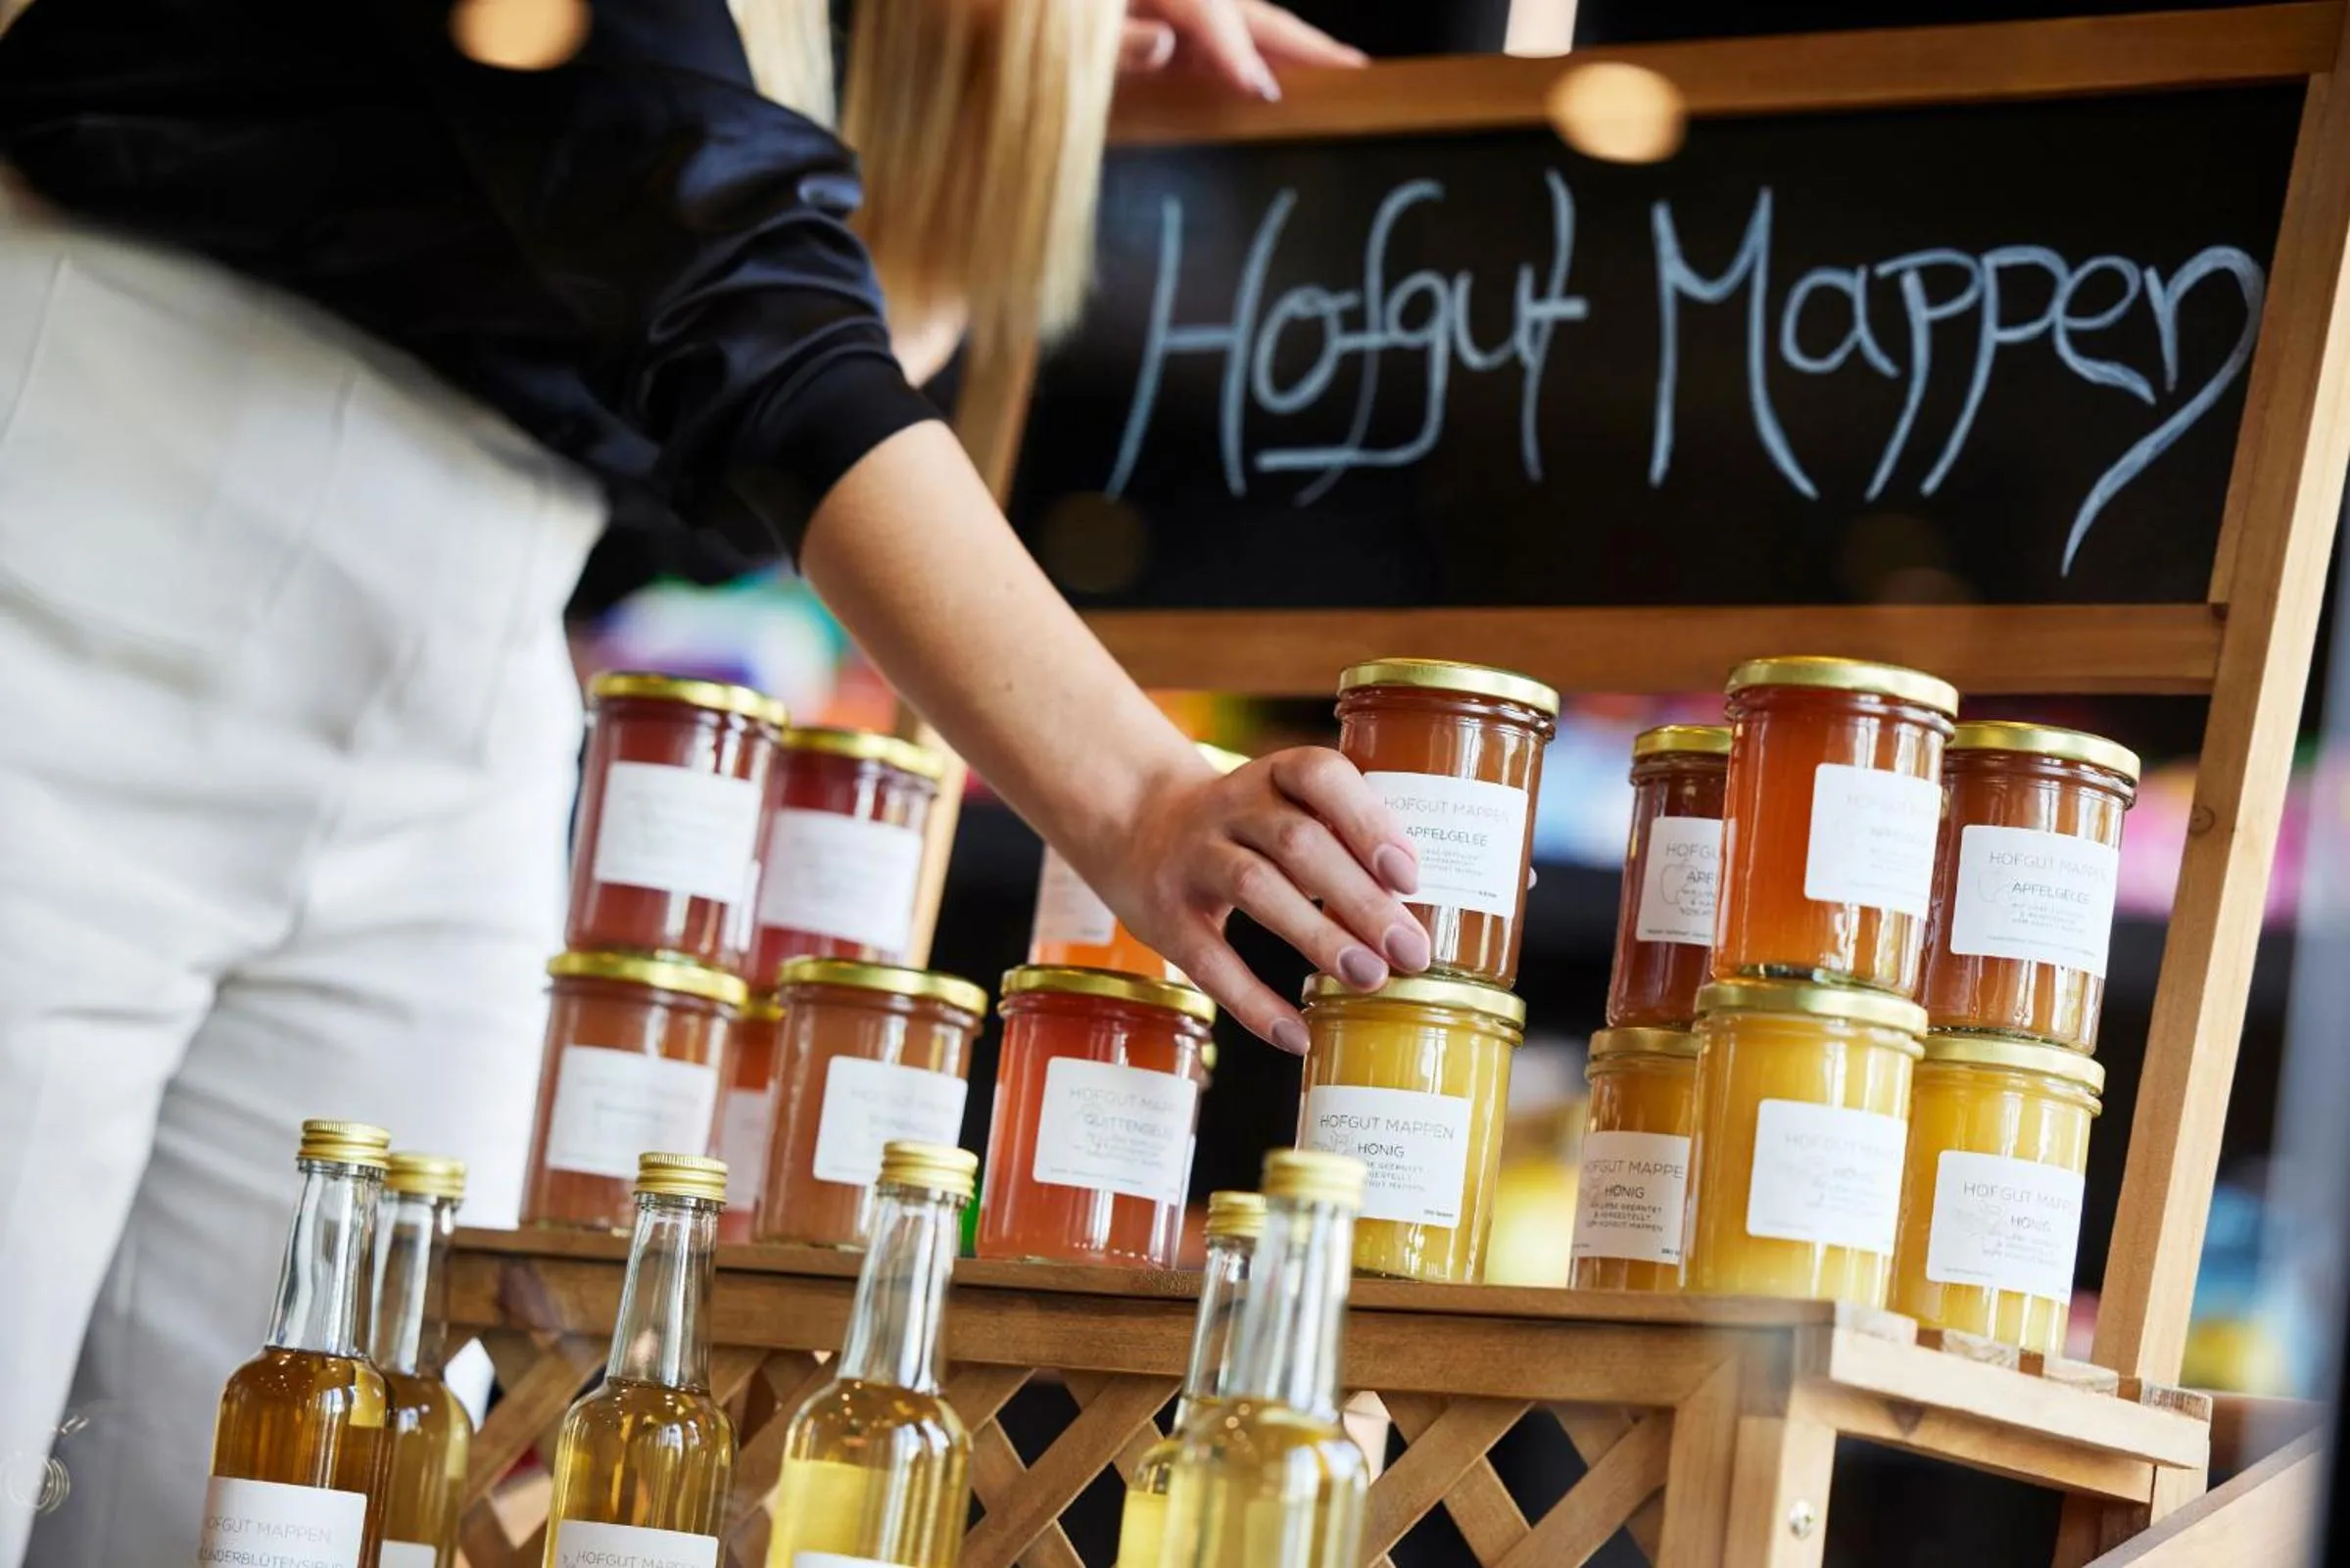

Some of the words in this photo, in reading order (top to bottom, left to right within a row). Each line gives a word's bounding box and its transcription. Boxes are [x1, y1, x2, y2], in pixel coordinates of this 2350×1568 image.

[1104, 169, 1586, 507] Hofgut
[1649, 186, 2266, 578] Mappen
[1383, 795, 1450, 815] HOFGUT
[1406, 826, 1489, 847] APFELGELEE
[1989, 850, 2054, 870] HOFGUT
[1319, 1115, 1380, 1130] HOFGUT
[1385, 1118, 1455, 1140] MAPPEN
[1357, 1142, 1405, 1159] HONIG
[1628, 1161, 1684, 1179] MAPPE
[1605, 1184, 1646, 1199] HONIG
[1963, 1180, 2032, 1204] HOFGUT
[257, 1520, 332, 1544] MAPPEN
[575, 1548, 639, 1568] HOFGUT
